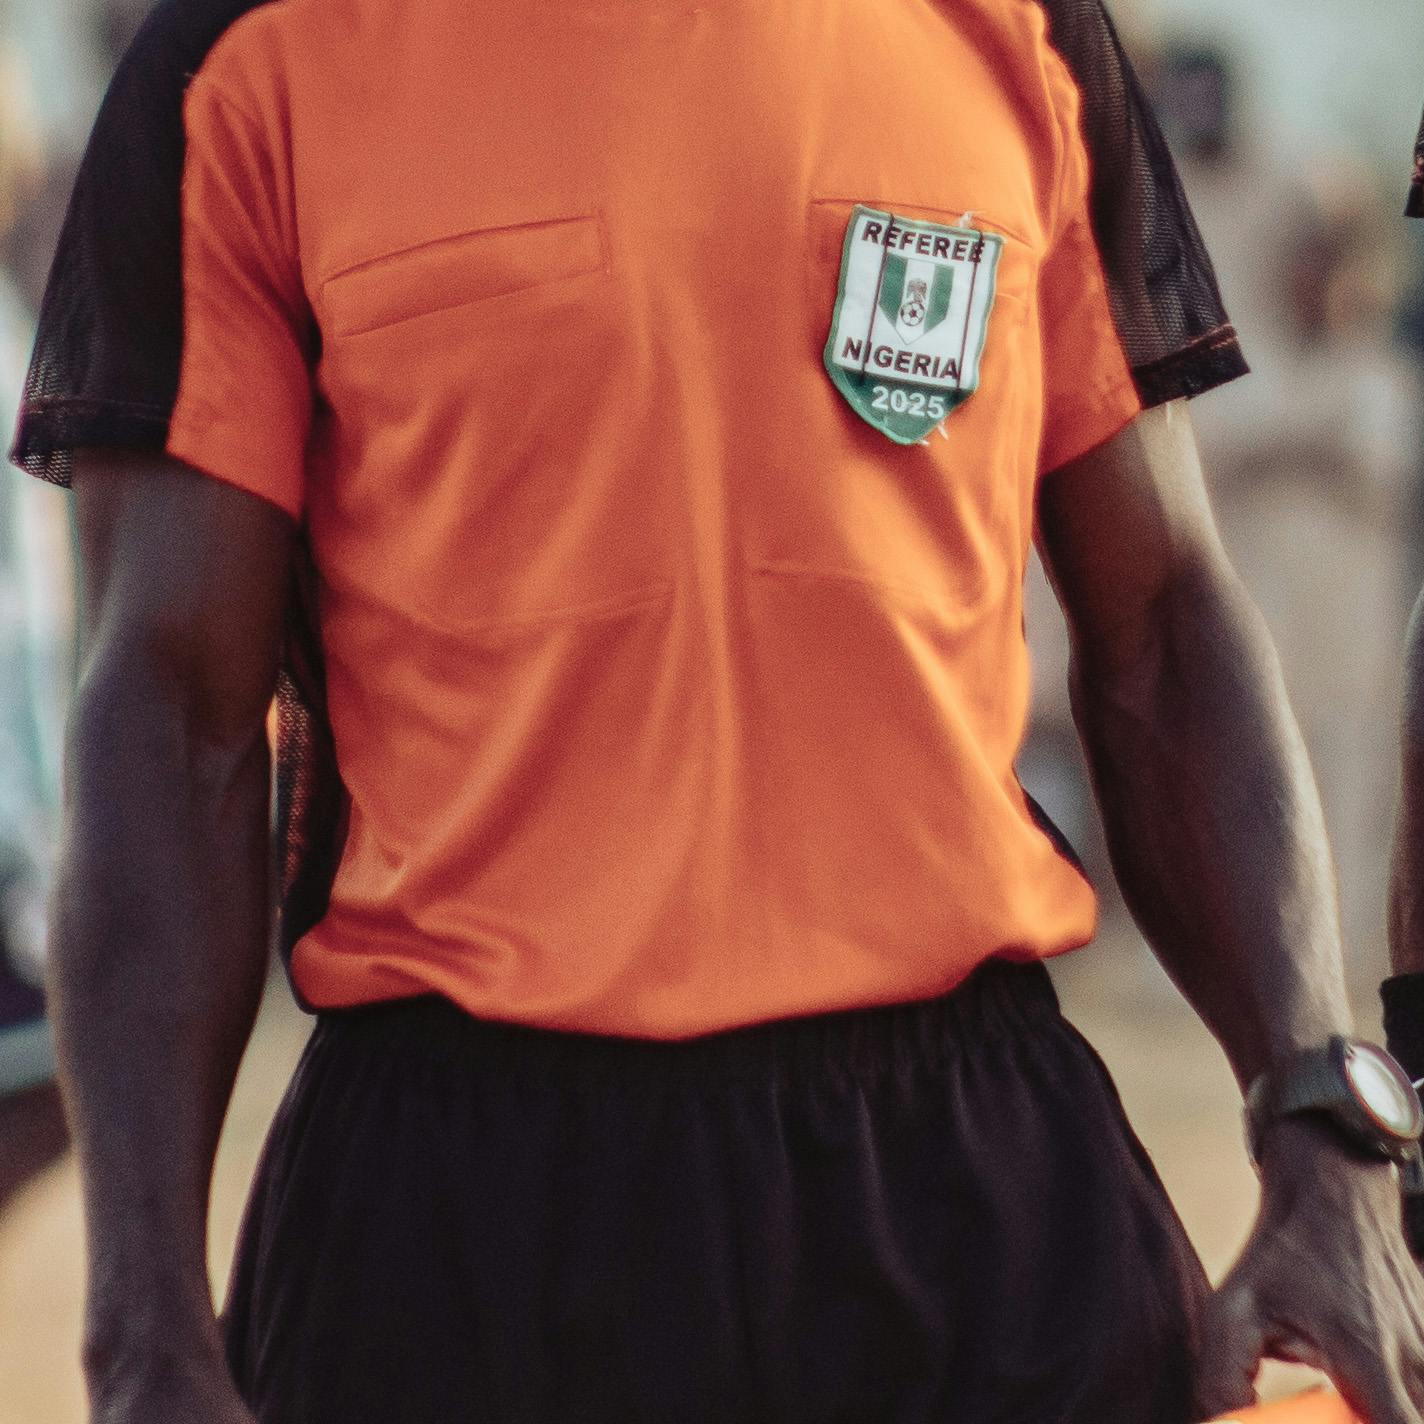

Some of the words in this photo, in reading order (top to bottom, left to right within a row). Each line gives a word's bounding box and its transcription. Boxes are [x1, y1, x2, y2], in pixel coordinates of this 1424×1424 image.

[861, 221, 986, 264] REFEREE
[842, 336, 961, 380] NIGERIA
[871, 385, 945, 419] 2025
